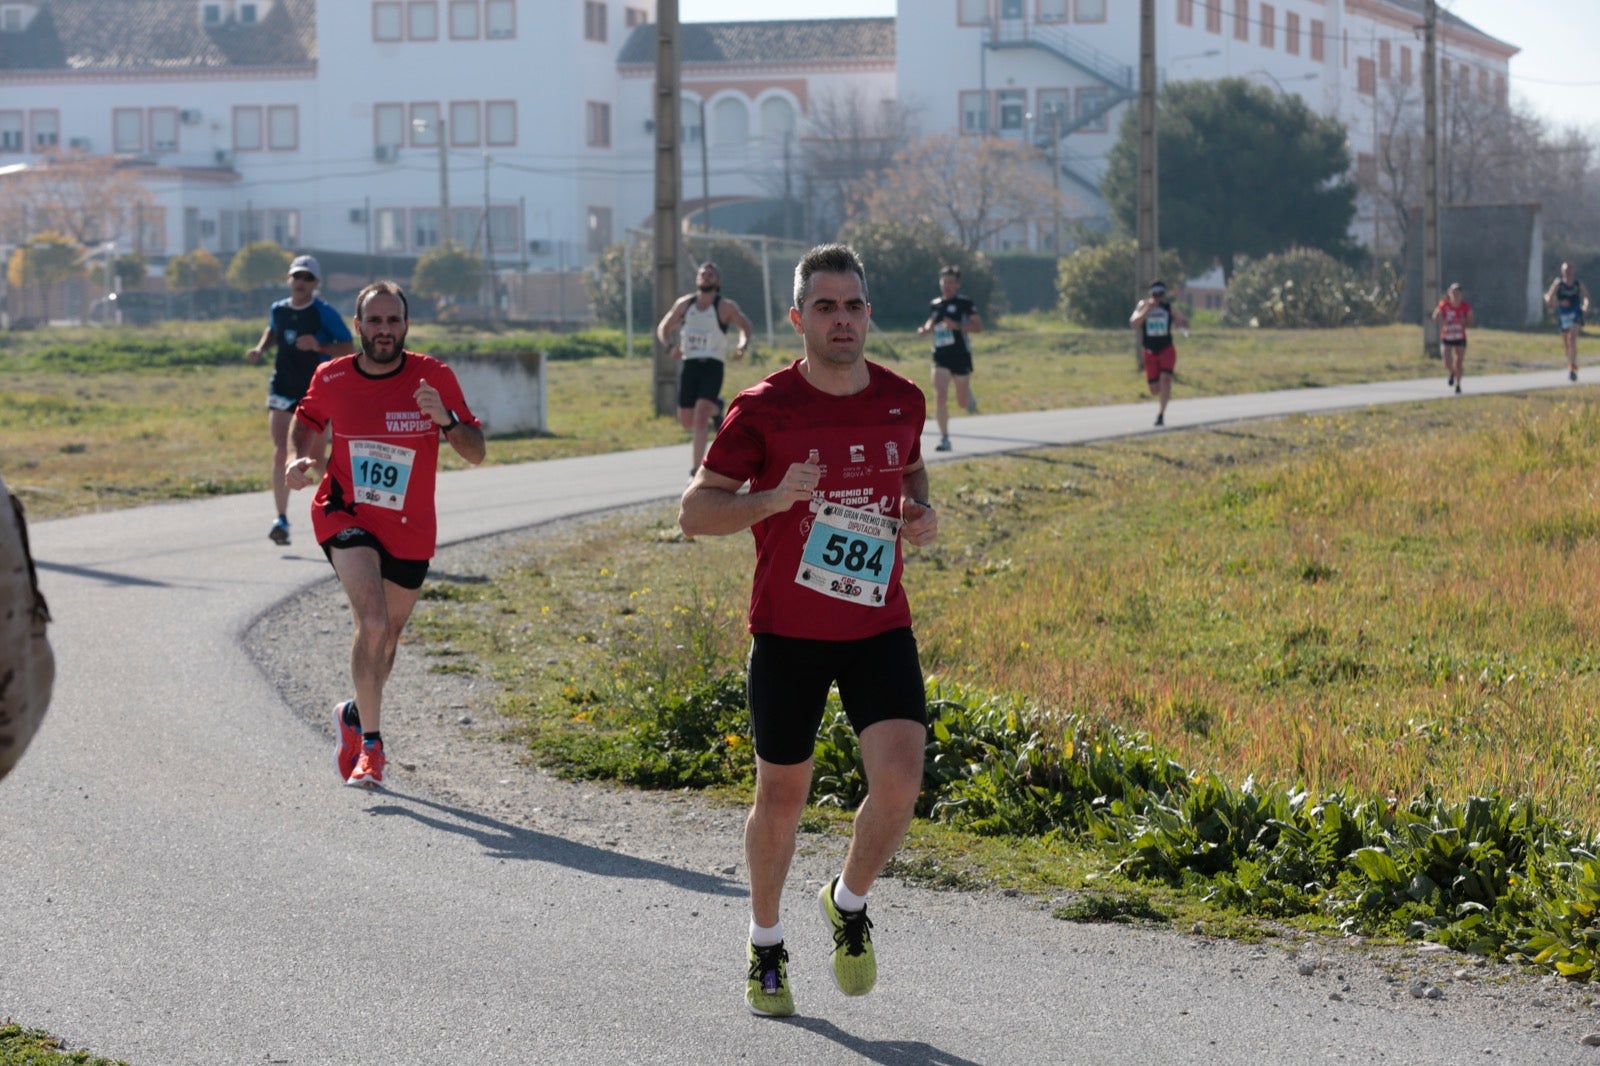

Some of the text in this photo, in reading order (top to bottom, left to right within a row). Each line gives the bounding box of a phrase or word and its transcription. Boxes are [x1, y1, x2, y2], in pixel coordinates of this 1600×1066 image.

[385, 411, 420, 420] RUNNING
[360, 460, 399, 488] 169
[829, 488, 861, 499] PREMIO
[863, 487, 874, 496] DE
[840, 496, 869, 506] FONDO
[844, 509, 860, 521] GRAN
[859, 512, 881, 526] PREMIO
[880, 518, 887, 527] DE
[822, 533, 884, 577] 584
